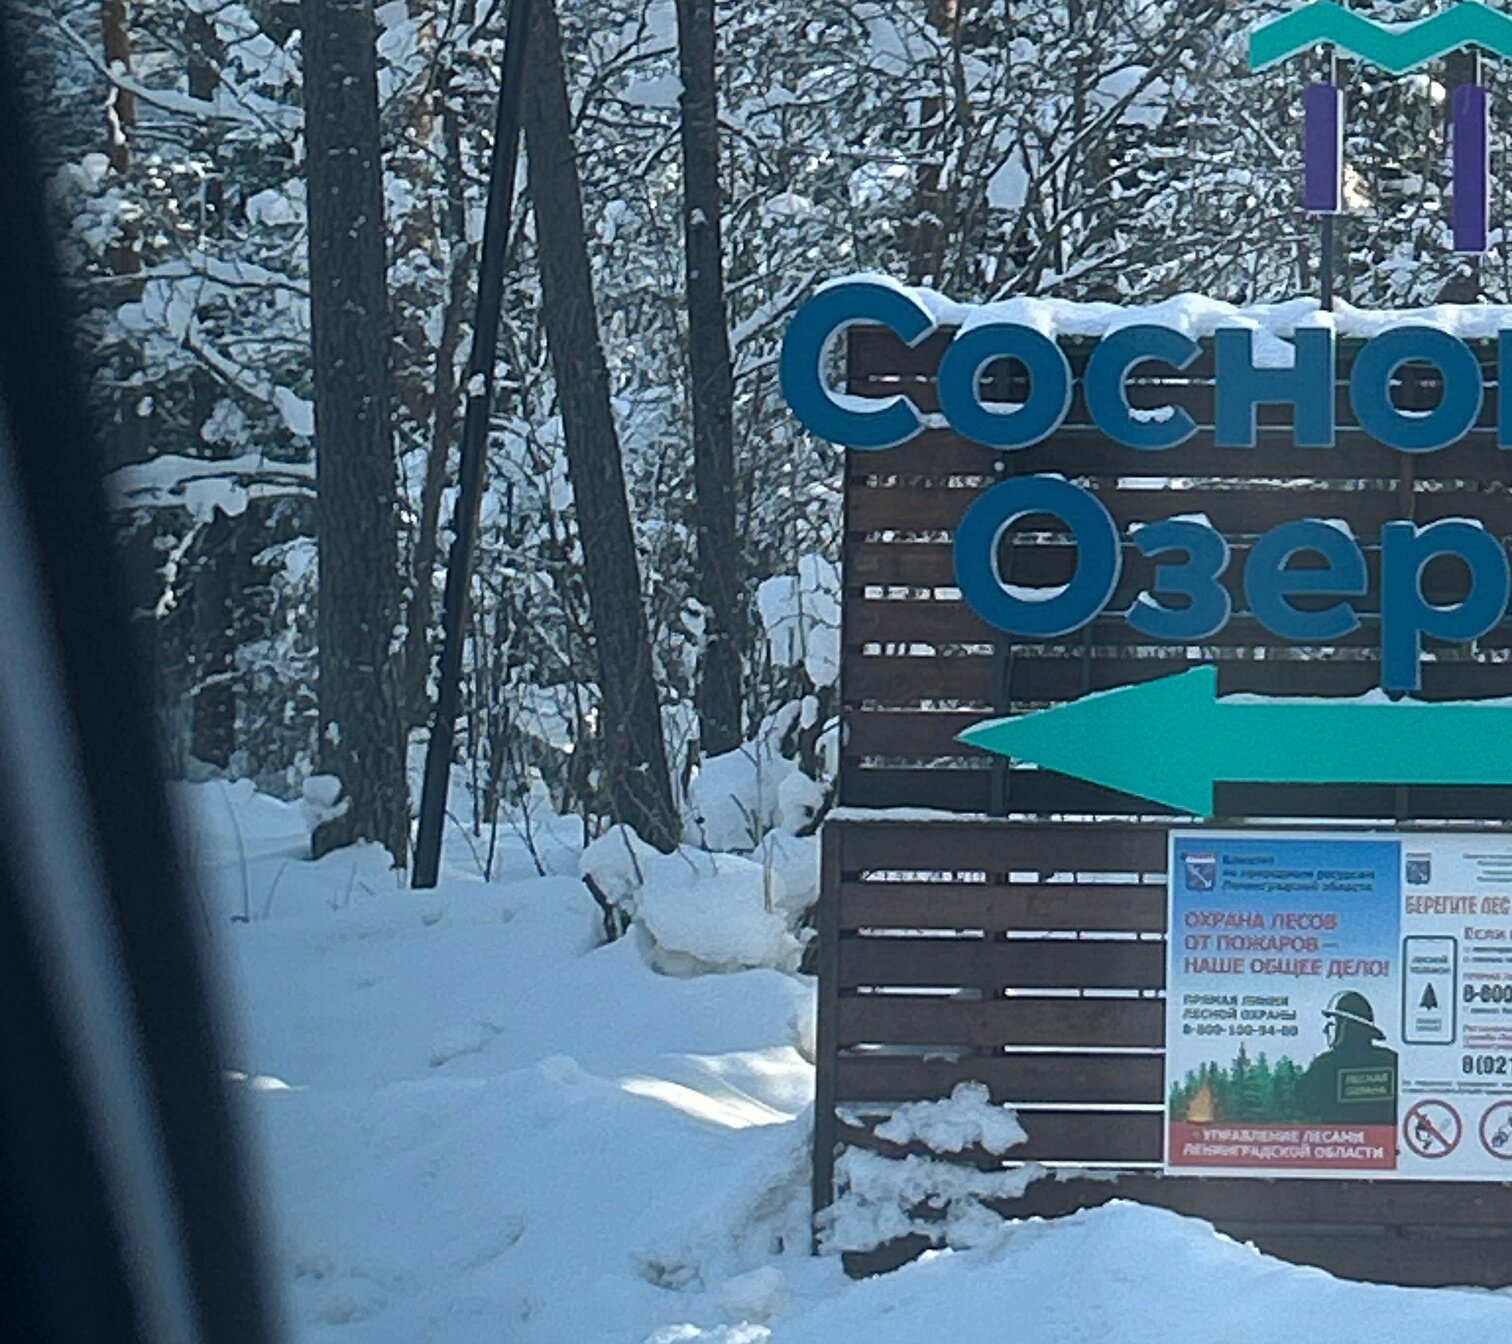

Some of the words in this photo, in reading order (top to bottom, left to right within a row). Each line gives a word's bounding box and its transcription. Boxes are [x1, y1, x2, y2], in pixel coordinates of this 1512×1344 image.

[1481, 896, 1511, 915] ЛЕС
[1184, 911, 1265, 929] ОХРАНА
[1271, 912, 1338, 930] ЛЕСОВ
[1184, 934, 1212, 951] ОТ
[1216, 935, 1319, 952] ПОЖАРОВ
[1184, 957, 1245, 974] НАШЕ
[1250, 958, 1322, 978] ОБЩЕЕ
[1326, 959, 1391, 979] ДЕЛО!
[1303, 1130, 1365, 1144] ЛЕСАМИ
[1314, 1145, 1385, 1160] ОБЛАСТИ
